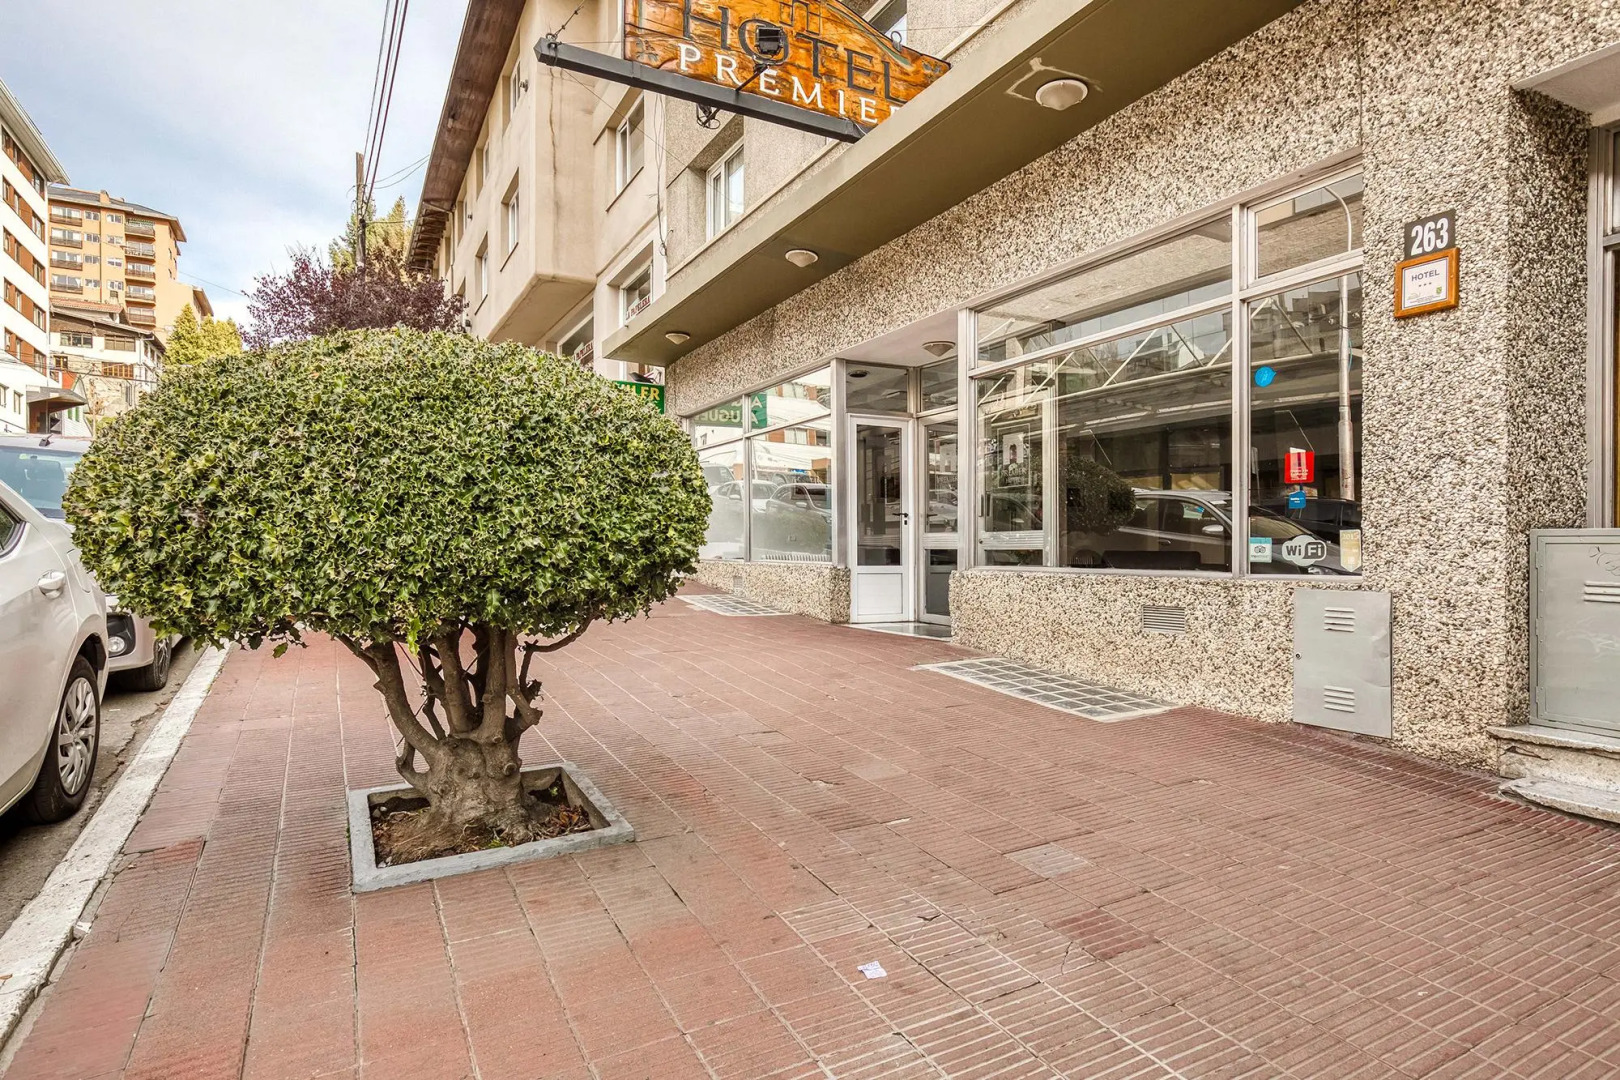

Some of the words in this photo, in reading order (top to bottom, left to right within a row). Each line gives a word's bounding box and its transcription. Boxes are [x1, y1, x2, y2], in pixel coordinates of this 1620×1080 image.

[677, 42, 901, 124] PREMIE
[682, 0, 908, 106] HOTEL
[1411, 217, 1449, 256] 263
[1411, 269, 1440, 282] HOTEL
